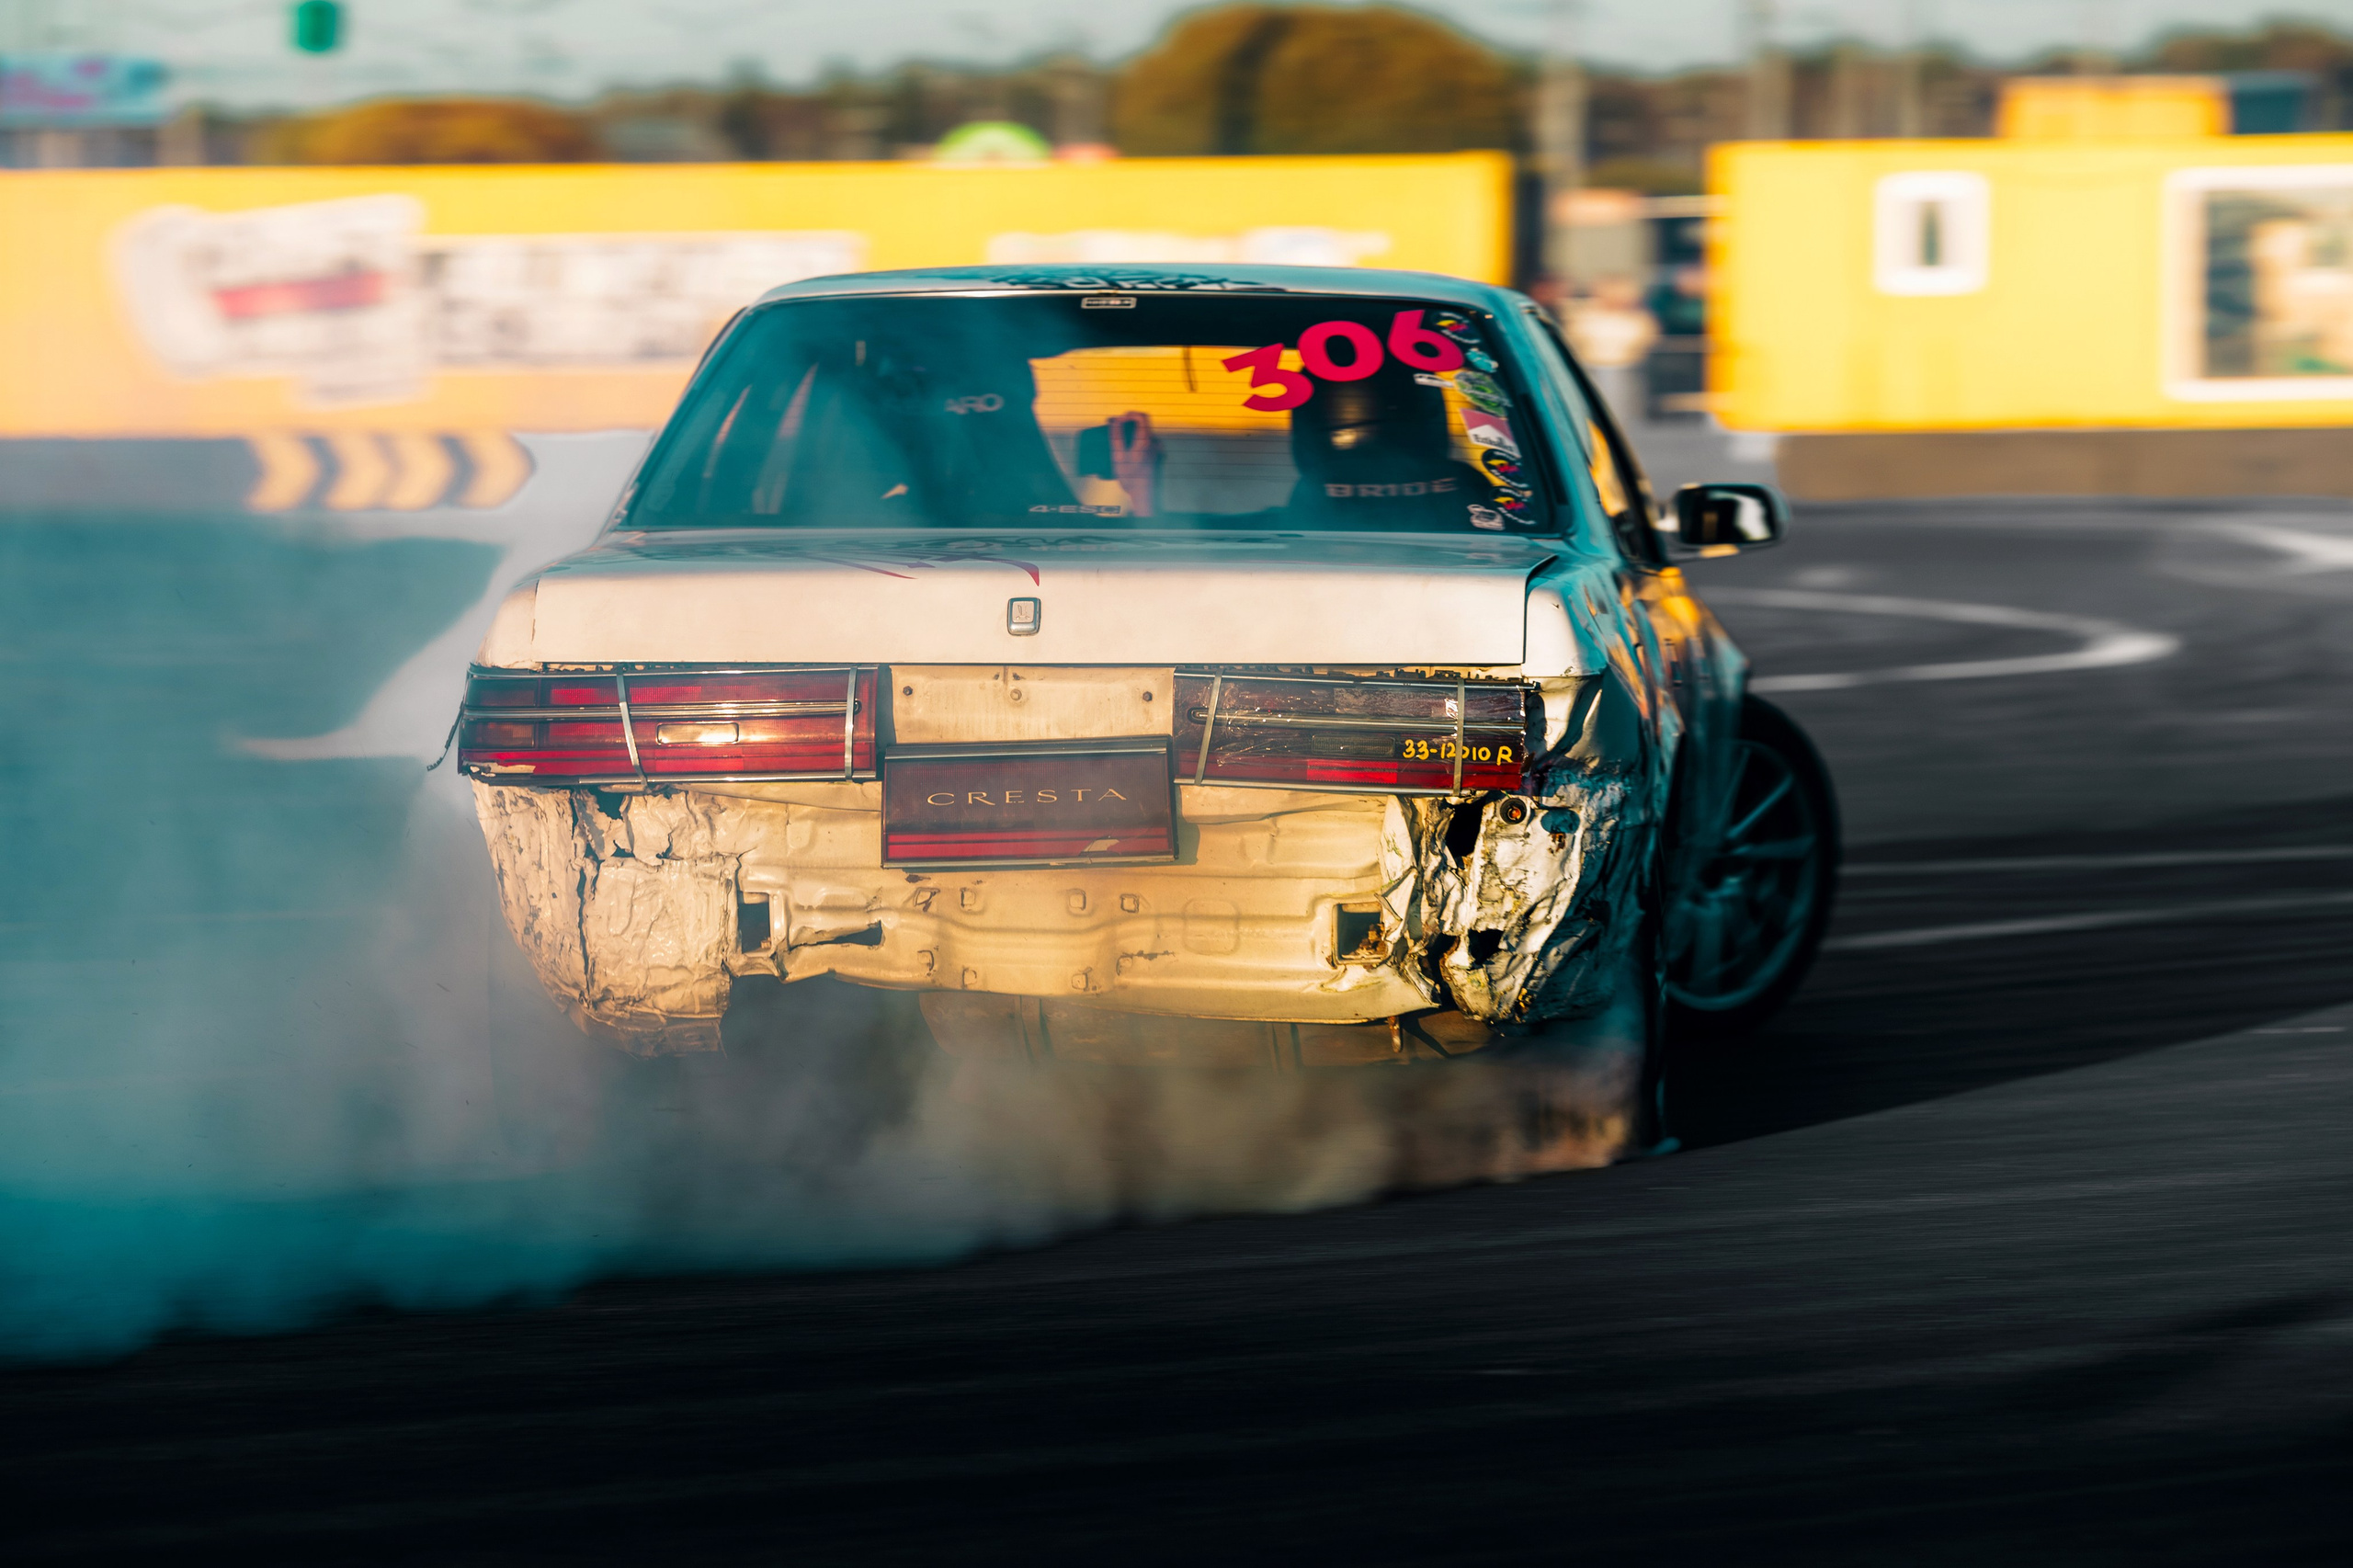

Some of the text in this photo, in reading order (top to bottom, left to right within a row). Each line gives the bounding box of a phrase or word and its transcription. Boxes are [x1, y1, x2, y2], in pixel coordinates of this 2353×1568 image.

[1221, 309, 1464, 412] 306
[1324, 477, 1458, 497] BRIDE
[926, 788, 1127, 806] CRESTA
